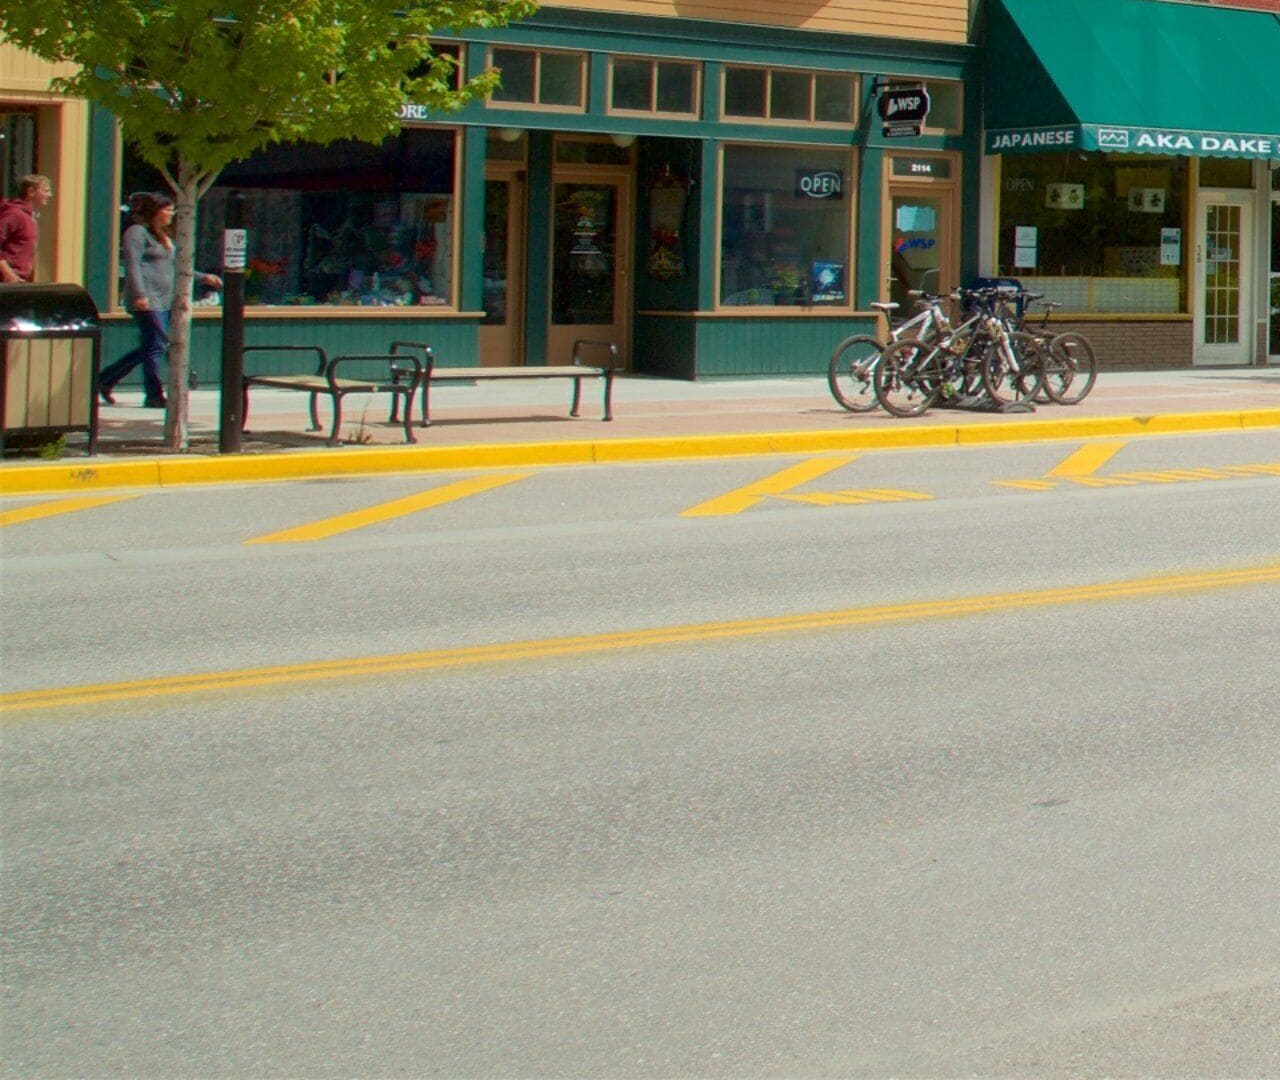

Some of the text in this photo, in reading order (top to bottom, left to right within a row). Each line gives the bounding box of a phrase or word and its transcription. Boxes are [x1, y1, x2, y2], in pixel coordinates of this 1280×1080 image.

[394, 104, 428, 119] ORE
[897, 96, 921, 111] WSP
[992, 130, 1075, 149] JAPANESE
[1136, 133, 1194, 150] AKA
[1201, 137, 1272, 153] DAKE
[799, 176, 841, 193] OPEN
[1006, 176, 1035, 192] OPEN
[910, 238, 936, 249] WSP
